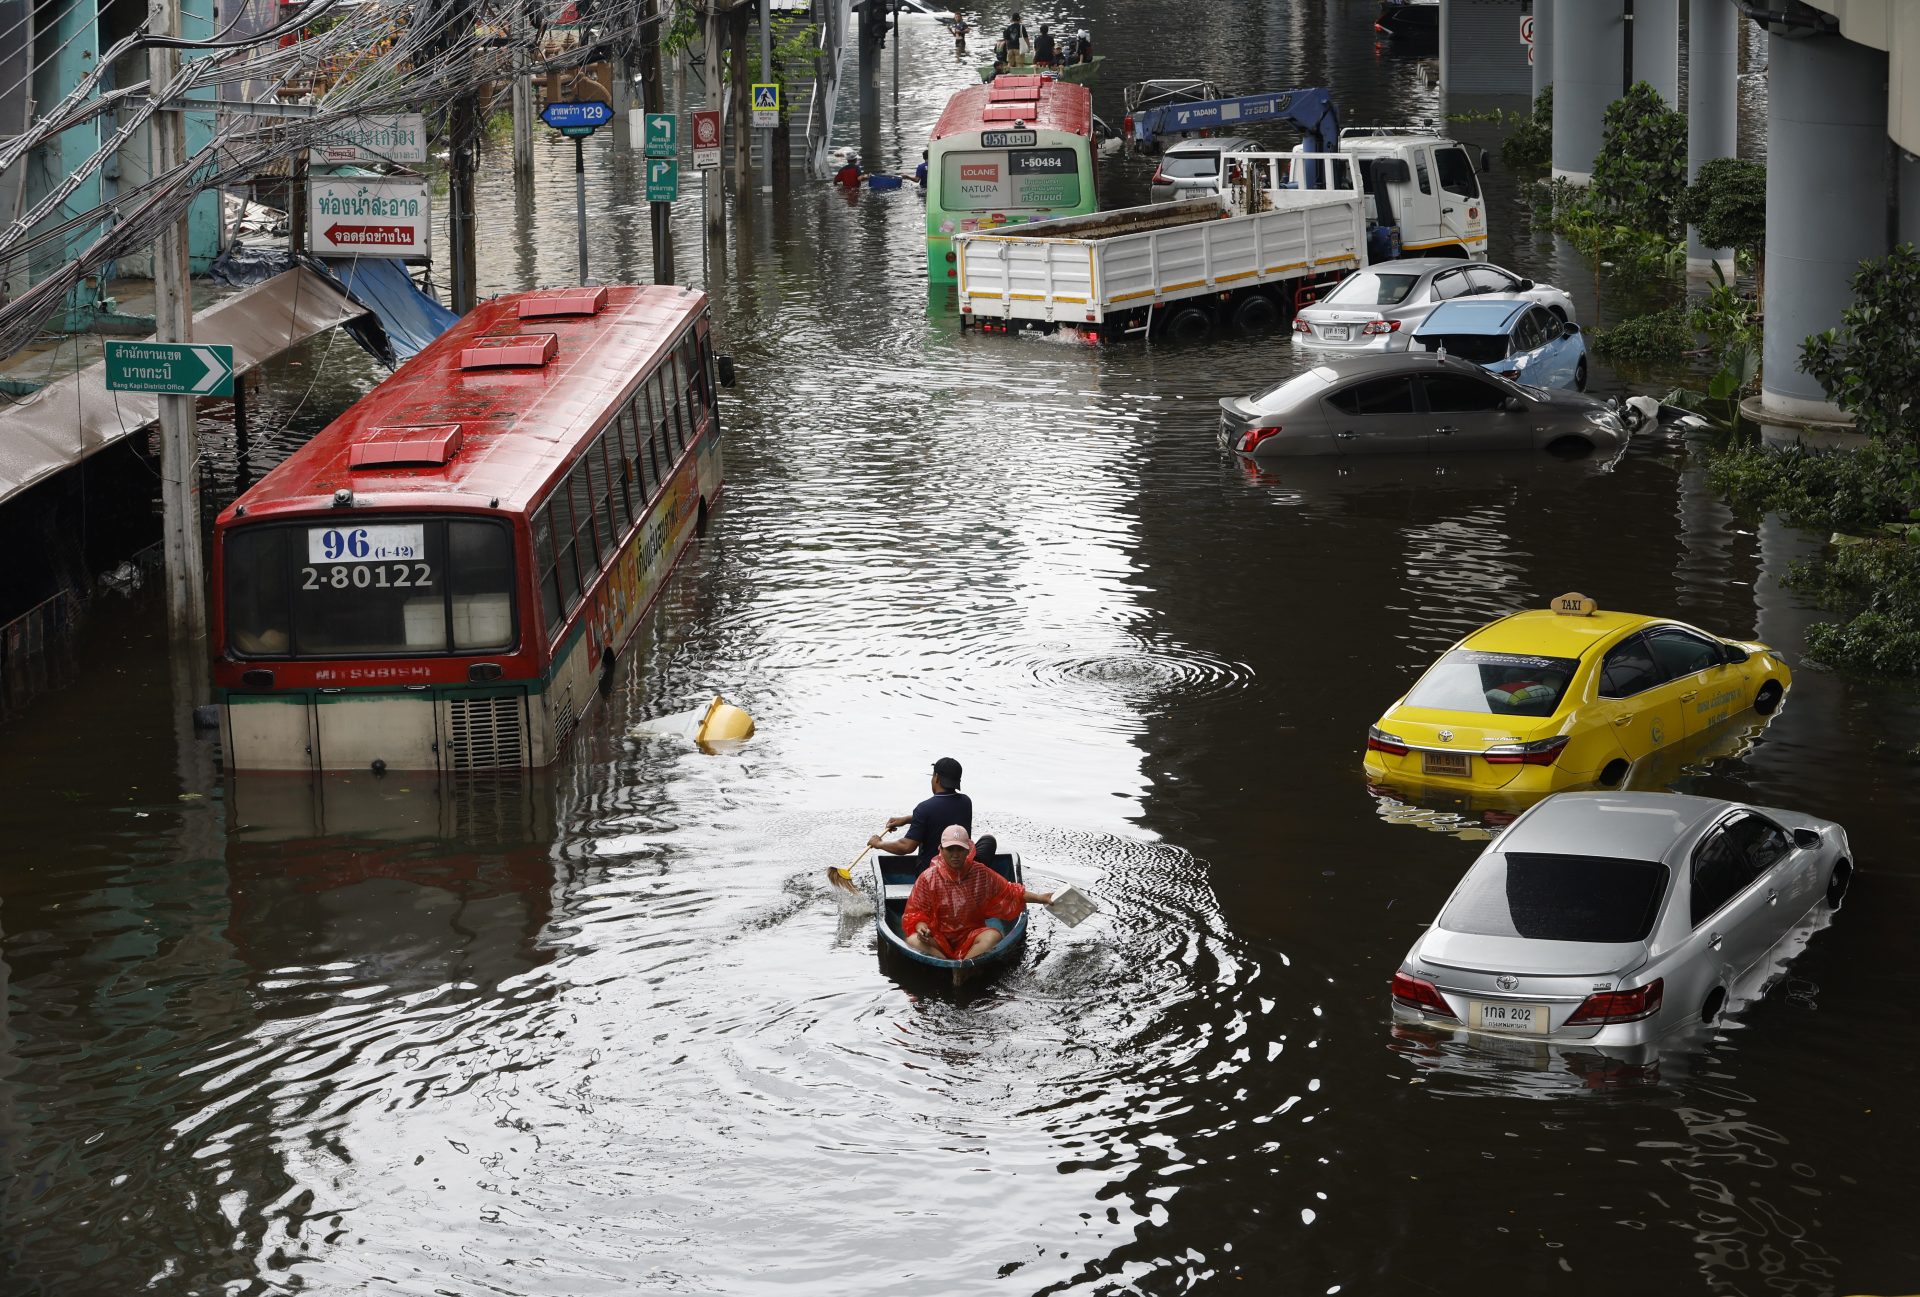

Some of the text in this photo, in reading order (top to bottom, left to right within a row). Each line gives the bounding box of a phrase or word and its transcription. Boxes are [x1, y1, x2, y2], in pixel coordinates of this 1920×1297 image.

[582, 106, 603, 118] 129
[1193, 107, 1217, 117] TADANO
[1020, 158, 1062, 168] 1-50484
[963, 168, 996, 176] LOLANE
[961, 185, 998, 193] NATURA
[318, 186, 419, 217] ห้องน้ำสะอาด
[334, 228, 412, 243] จอดรถข้างใน
[115, 345, 182, 361] สำนักงานเขต
[123, 363, 172, 380] บางกะปิ
[112, 382, 128, 390] Bang
[129, 382, 143, 390] Kapi
[322, 528, 414, 560] 96 (1-42)
[301, 563, 433, 590] 2-80122
[1561, 599, 1581, 610] TAXI
[315, 666, 431, 680] MITSUBISHI
[1484, 1006, 1531, 1021] 1กล 202
